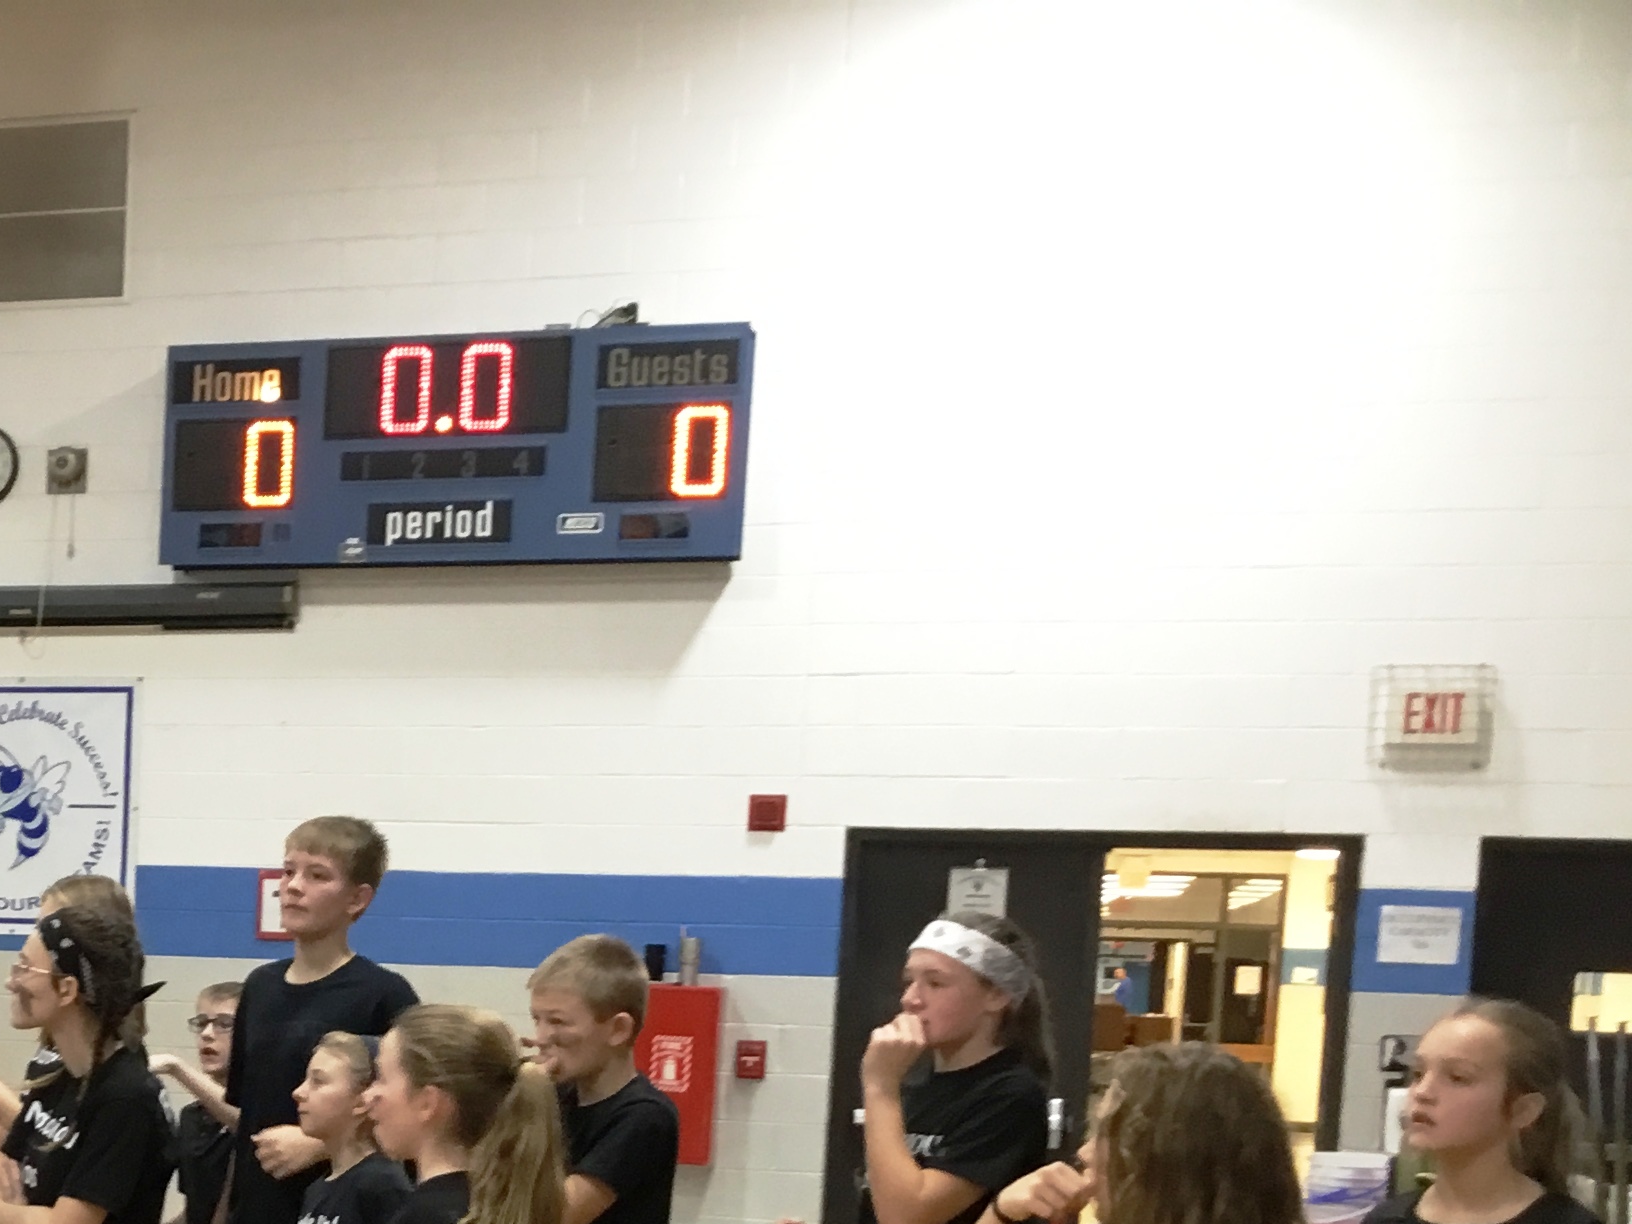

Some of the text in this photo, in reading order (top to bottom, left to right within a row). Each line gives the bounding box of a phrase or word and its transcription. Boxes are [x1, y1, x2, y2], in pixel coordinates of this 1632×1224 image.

[192, 364, 282, 403] Home
[379, 341, 514, 434] 0.0
[607, 349, 729, 387] Guests
[242, 419, 296, 508] 0
[670, 403, 732, 498] 0
[385, 500, 494, 546] period
[1403, 692, 1466, 735] EXIT
